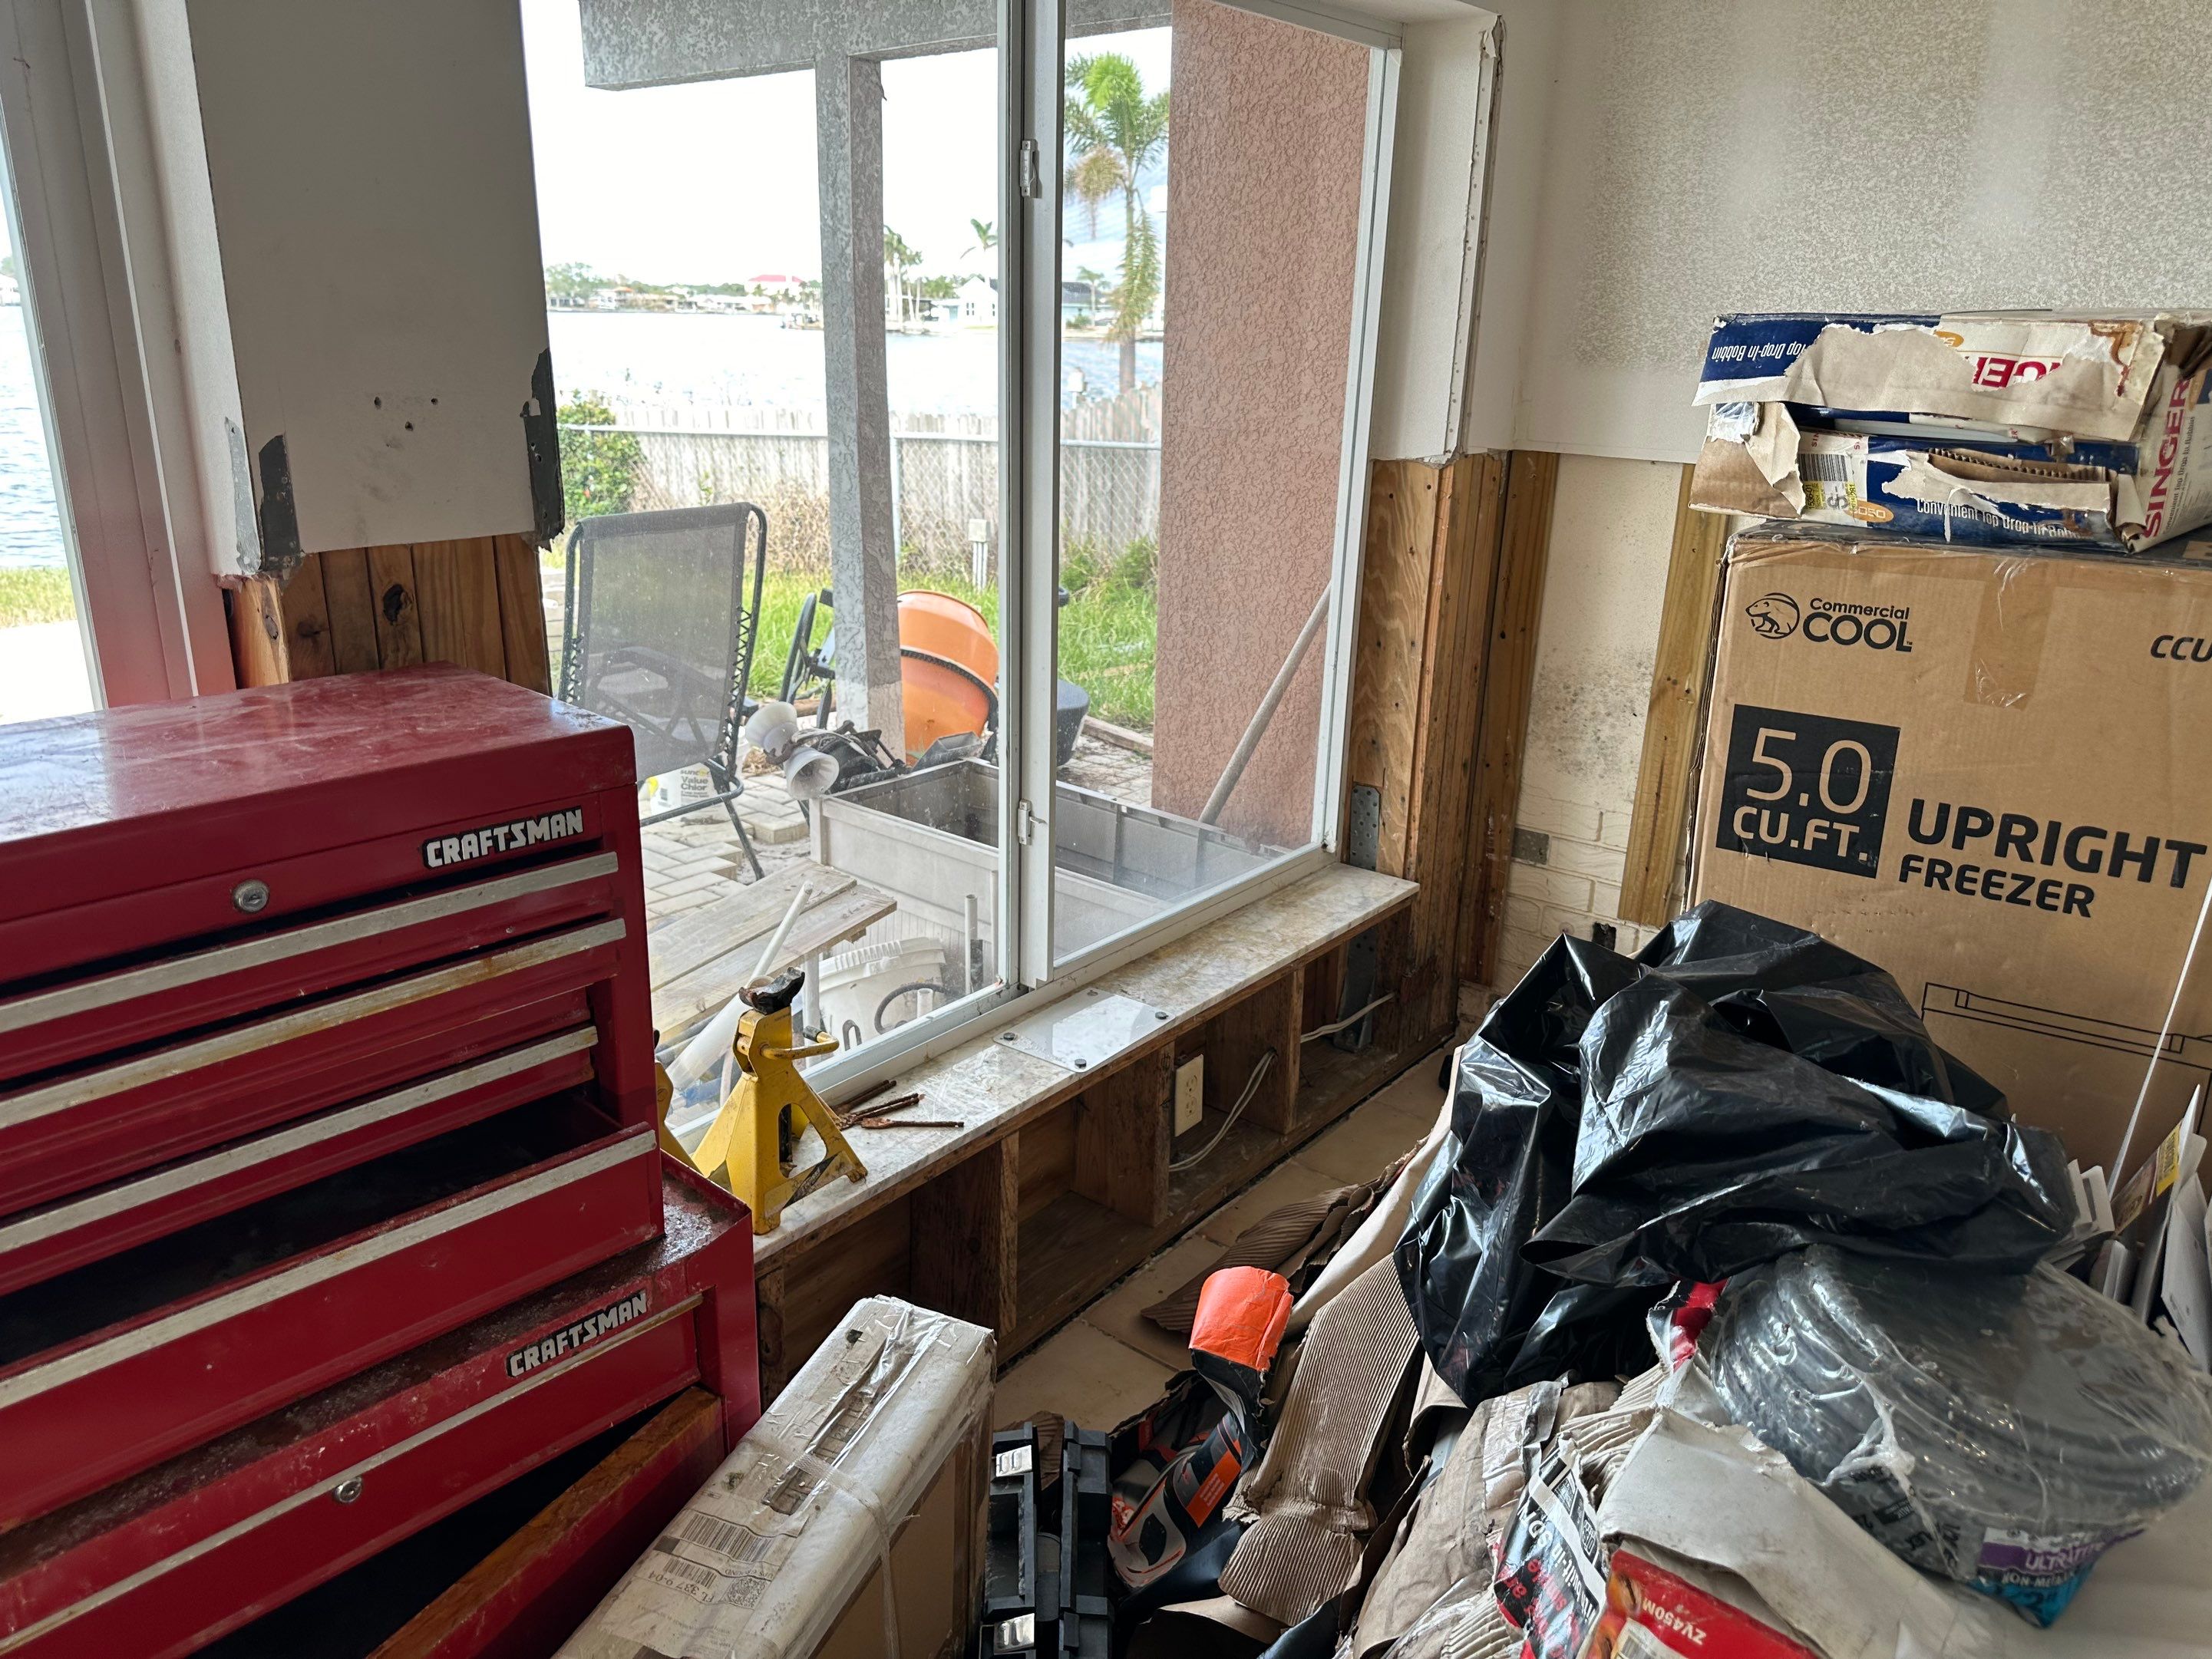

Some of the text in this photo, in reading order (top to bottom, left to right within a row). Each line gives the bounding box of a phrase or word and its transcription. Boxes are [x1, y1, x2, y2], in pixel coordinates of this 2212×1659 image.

[1712, 345, 1747, 362] Bobbin
[1748, 343, 1786, 361] Drop-In
[2141, 380, 2190, 537] SINGER
[1917, 499, 1979, 521] Convenient
[1803, 612, 1912, 652] COOL
[1810, 598, 1910, 620] Commercial
[681, 776, 708, 784] Value
[1746, 727, 1871, 814] 5.0
[426, 809, 583, 868] CRAFTSMAN
[1733, 806, 1867, 861] CU.FT.
[1908, 798, 2207, 889] UPRIGHT
[1899, 854, 2095, 919] FREEZER
[510, 1293, 648, 1377] CRAFTSMAN
